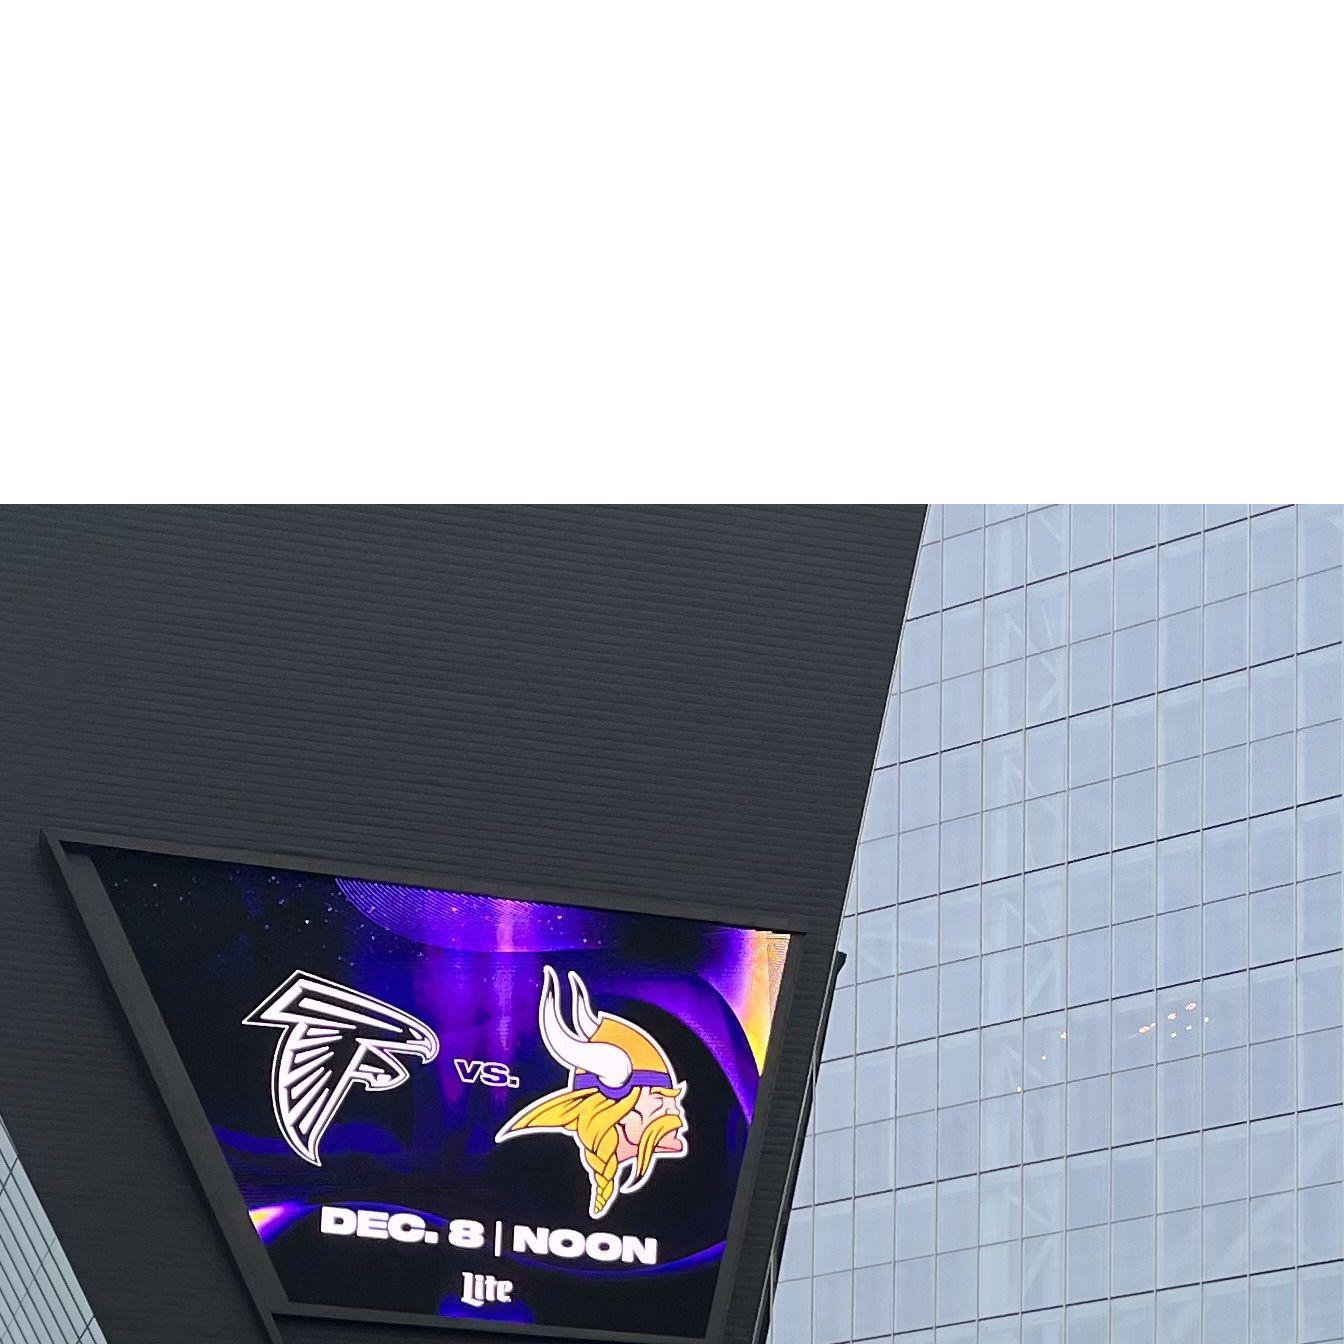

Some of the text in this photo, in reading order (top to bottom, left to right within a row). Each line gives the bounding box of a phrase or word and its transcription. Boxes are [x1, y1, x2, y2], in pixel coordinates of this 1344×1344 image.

[320, 1206, 657, 1264] DEC. 8 NOON
[461, 1271, 513, 1306] Lite
